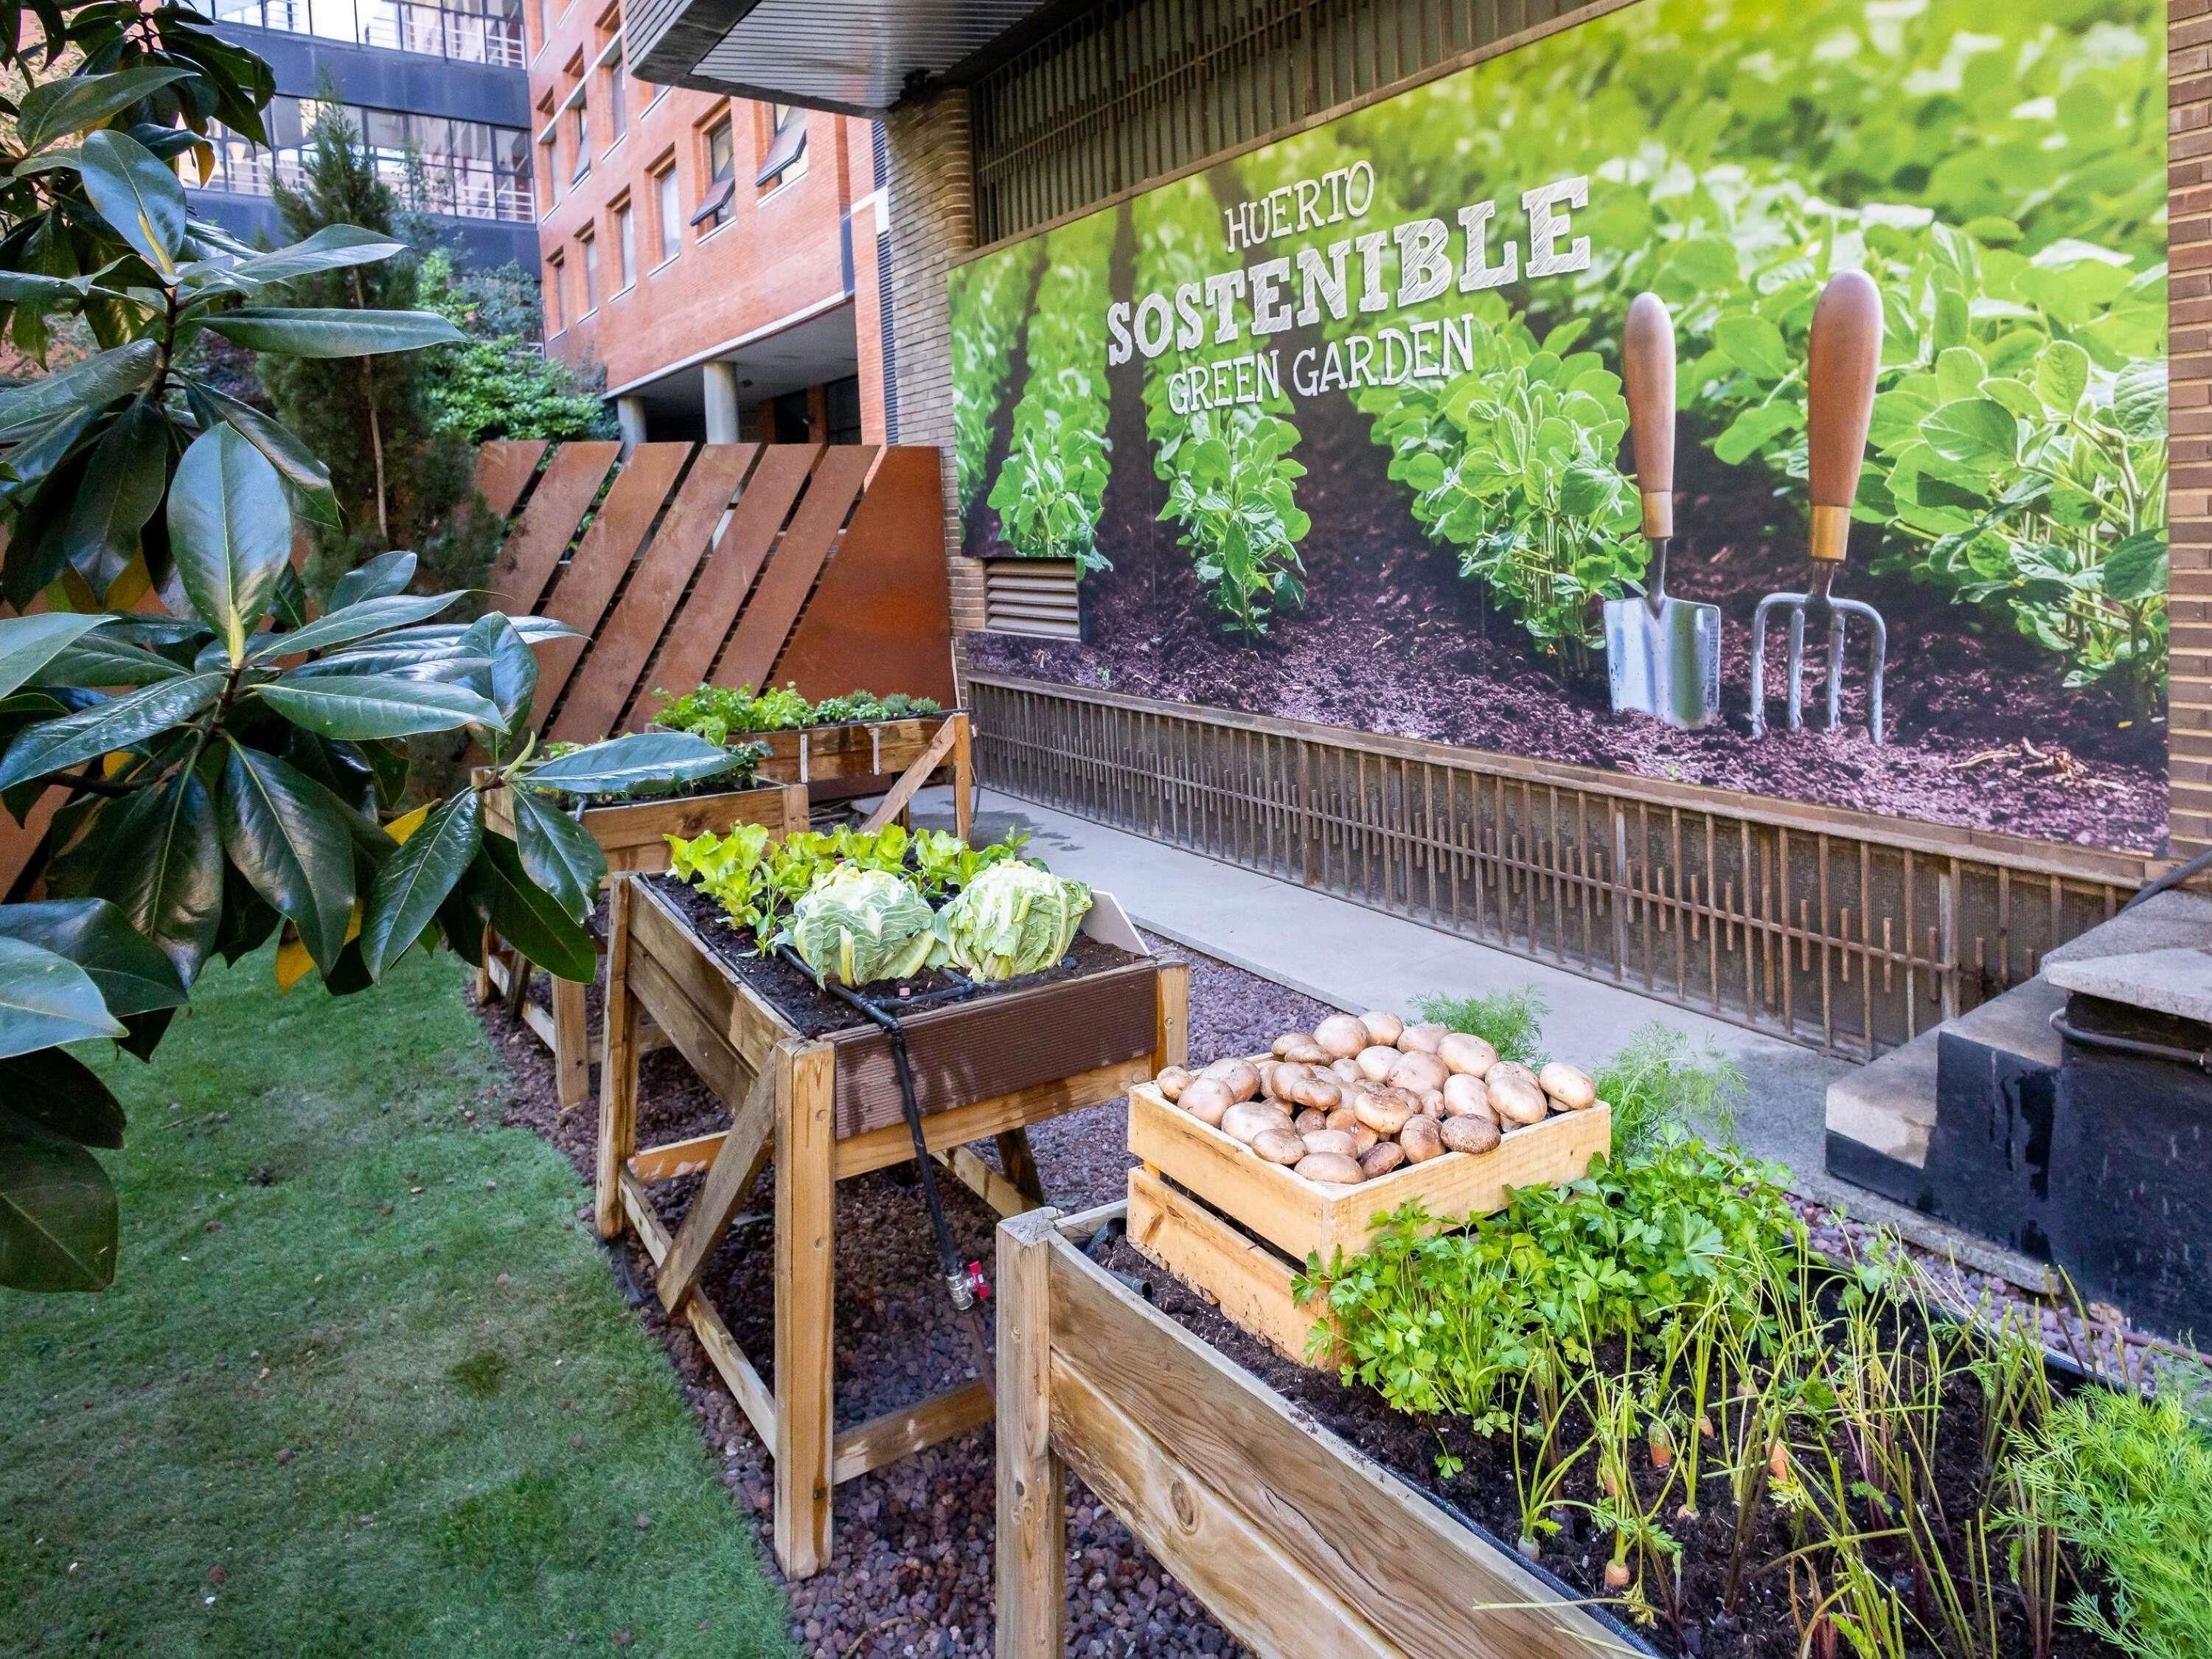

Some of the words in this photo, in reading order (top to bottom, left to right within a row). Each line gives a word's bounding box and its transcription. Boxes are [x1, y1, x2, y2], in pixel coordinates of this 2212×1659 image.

[1225, 160, 1374, 254] HUERTO
[1107, 175, 1591, 366] SOSTENIBLE
[1168, 349, 1280, 415] GREEN
[1293, 313, 1474, 397] GARDEN
